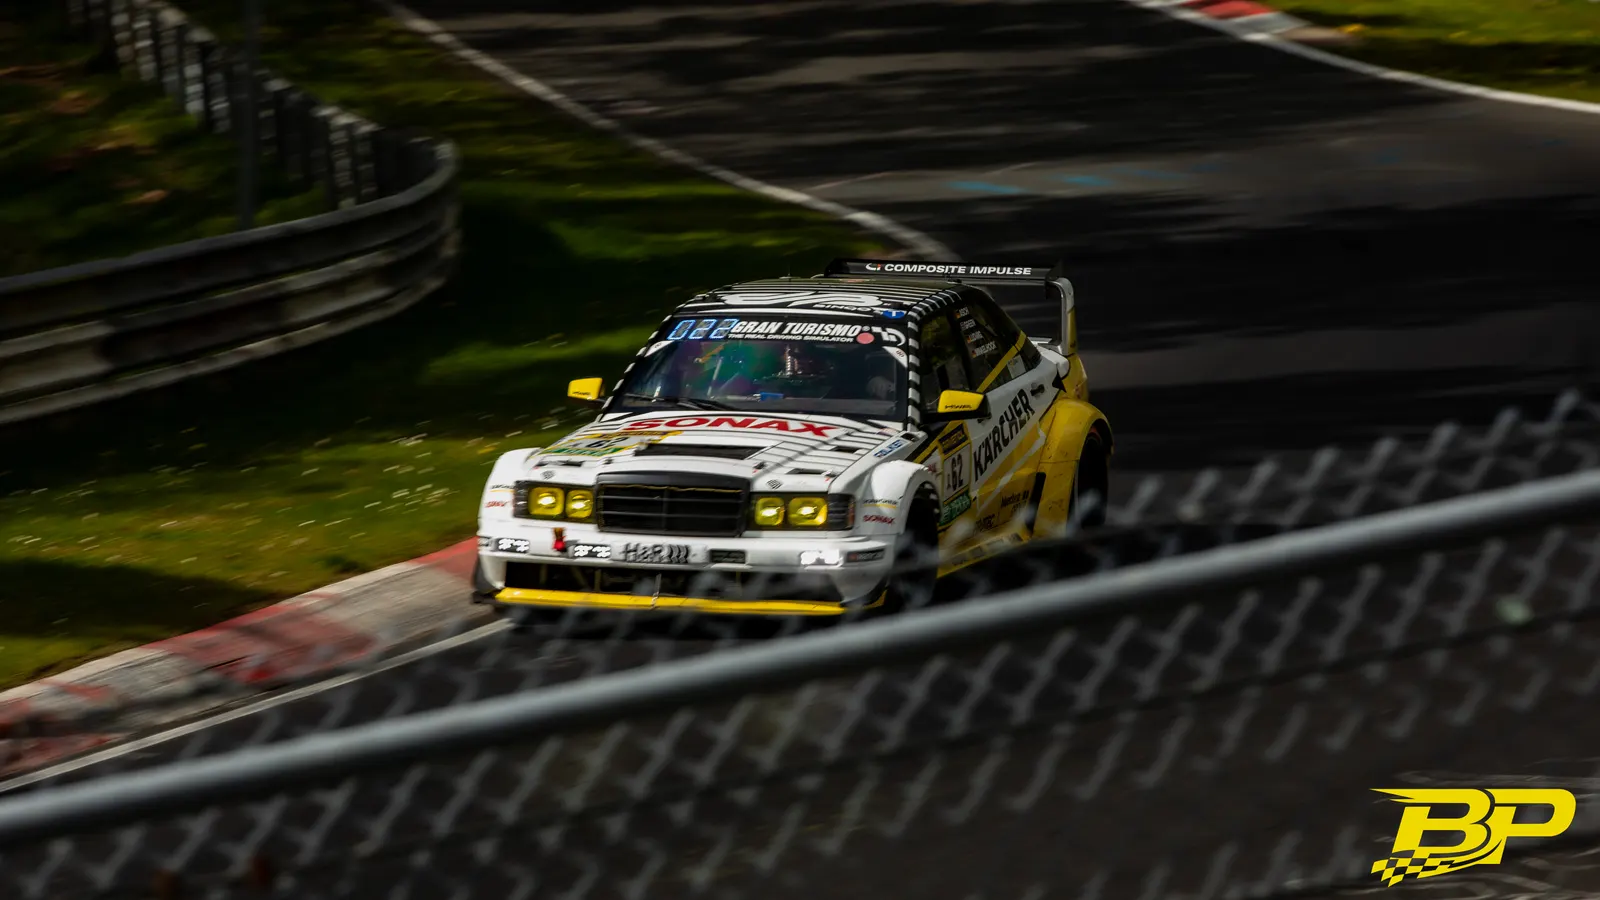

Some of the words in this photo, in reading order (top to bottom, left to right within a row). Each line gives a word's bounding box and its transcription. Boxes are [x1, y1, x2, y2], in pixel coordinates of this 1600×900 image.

[884, 263, 966, 274] COMPOSITE
[969, 266, 1032, 275] IMPULSE
[666, 318, 740, 340] 022
[730, 321, 784, 334] GRAN
[781, 322, 862, 337] TURISMO
[802, 335, 855, 343] SIMULATOR
[622, 417, 838, 438] SONAX
[973, 388, 1036, 482] KÄRCHER
[950, 453, 964, 491] 62
